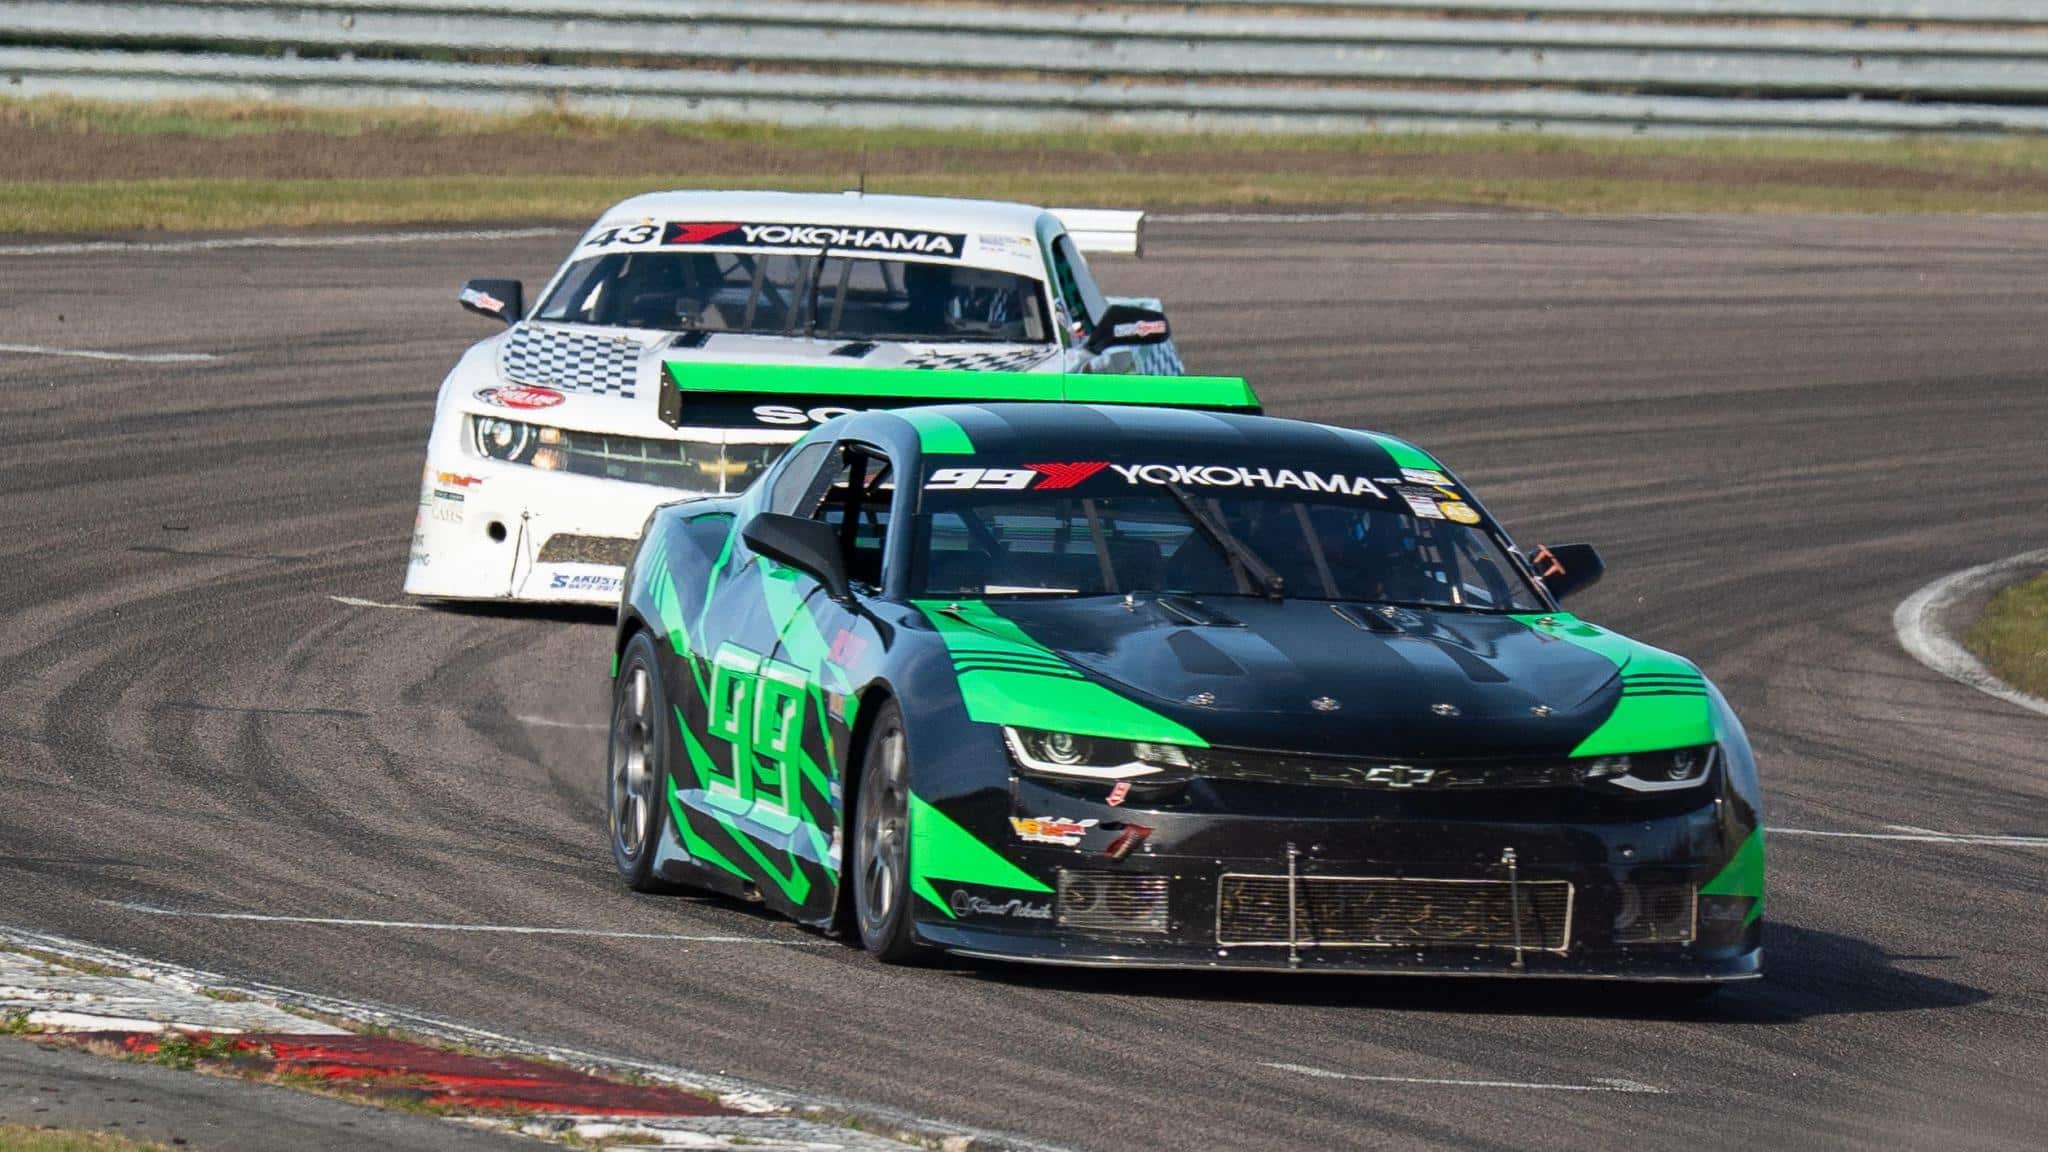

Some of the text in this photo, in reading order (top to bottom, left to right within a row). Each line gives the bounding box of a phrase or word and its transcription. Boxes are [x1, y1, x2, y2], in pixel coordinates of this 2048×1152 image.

[584, 225, 660, 247] 43
[741, 225, 955, 253] YOKOHAMA
[924, 468, 1038, 490] 99
[1110, 464, 1389, 499] YOKOHAMA
[704, 640, 811, 835] 99
